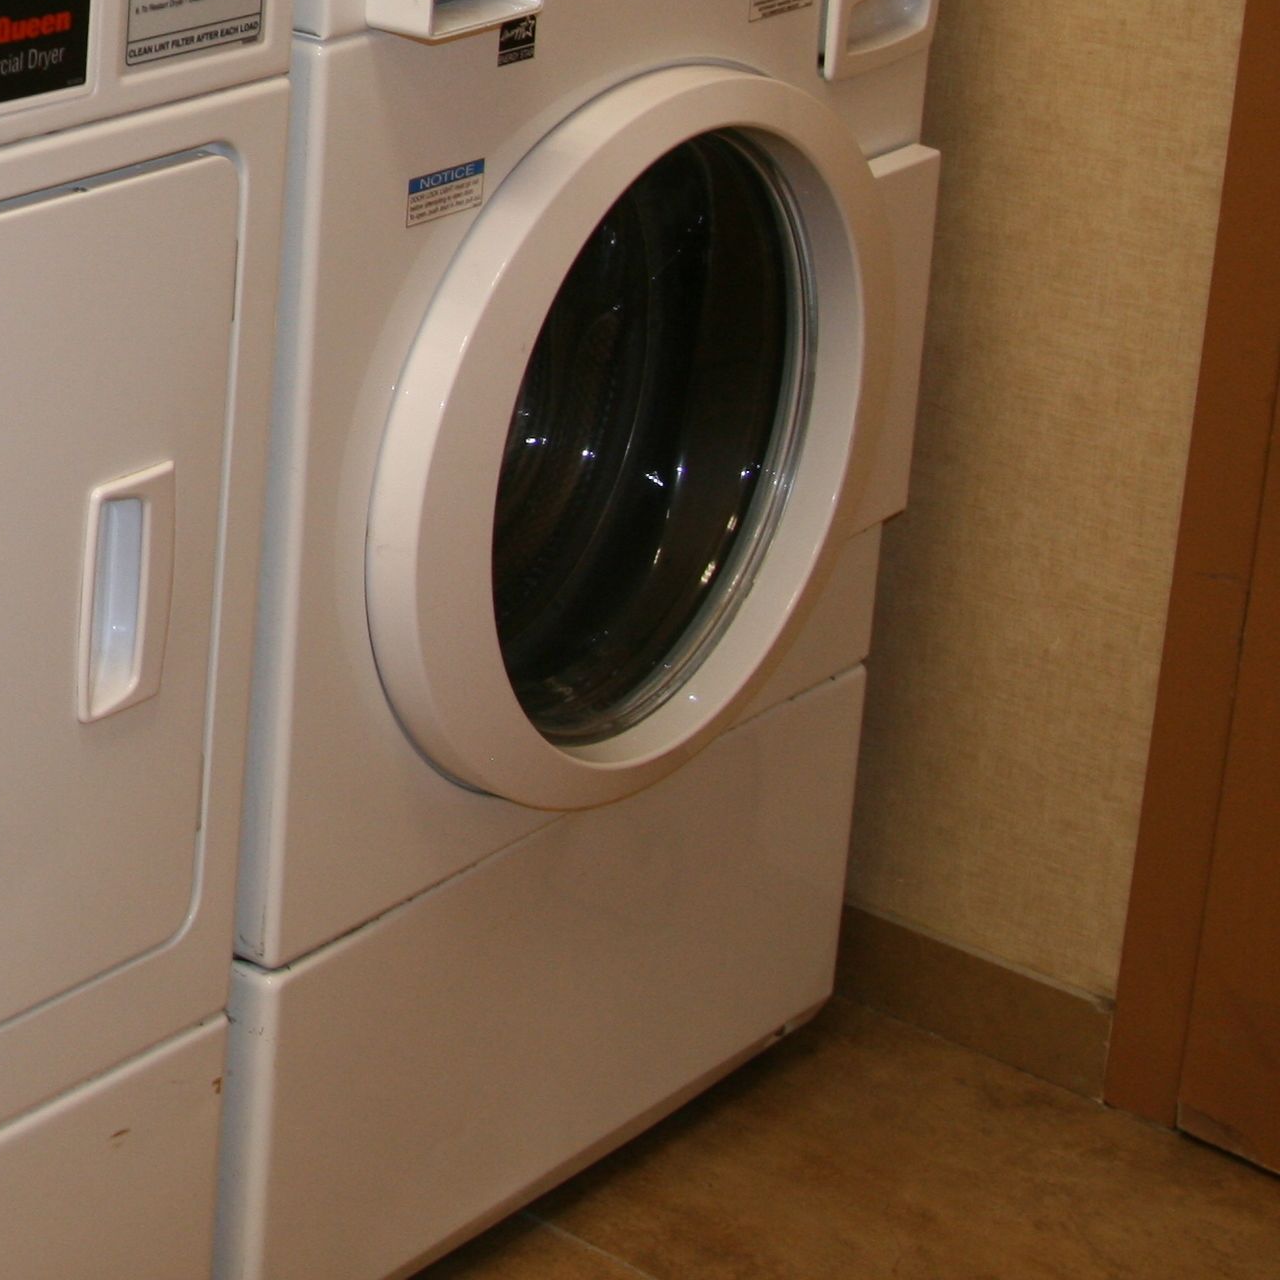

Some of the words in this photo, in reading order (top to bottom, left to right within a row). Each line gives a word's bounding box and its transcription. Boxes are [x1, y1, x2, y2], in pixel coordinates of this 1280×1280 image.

[128, 45, 153, 58] CLEAN
[154, 41, 169, 53] LINT
[171, 36, 195, 49] FILTER
[195, 30, 219, 43] AFTER
[220, 26, 239, 37] EACH
[240, 21, 259, 33] LOAD
[28, 46, 66, 70] Dryer
[420, 163, 476, 190] NOTICE
